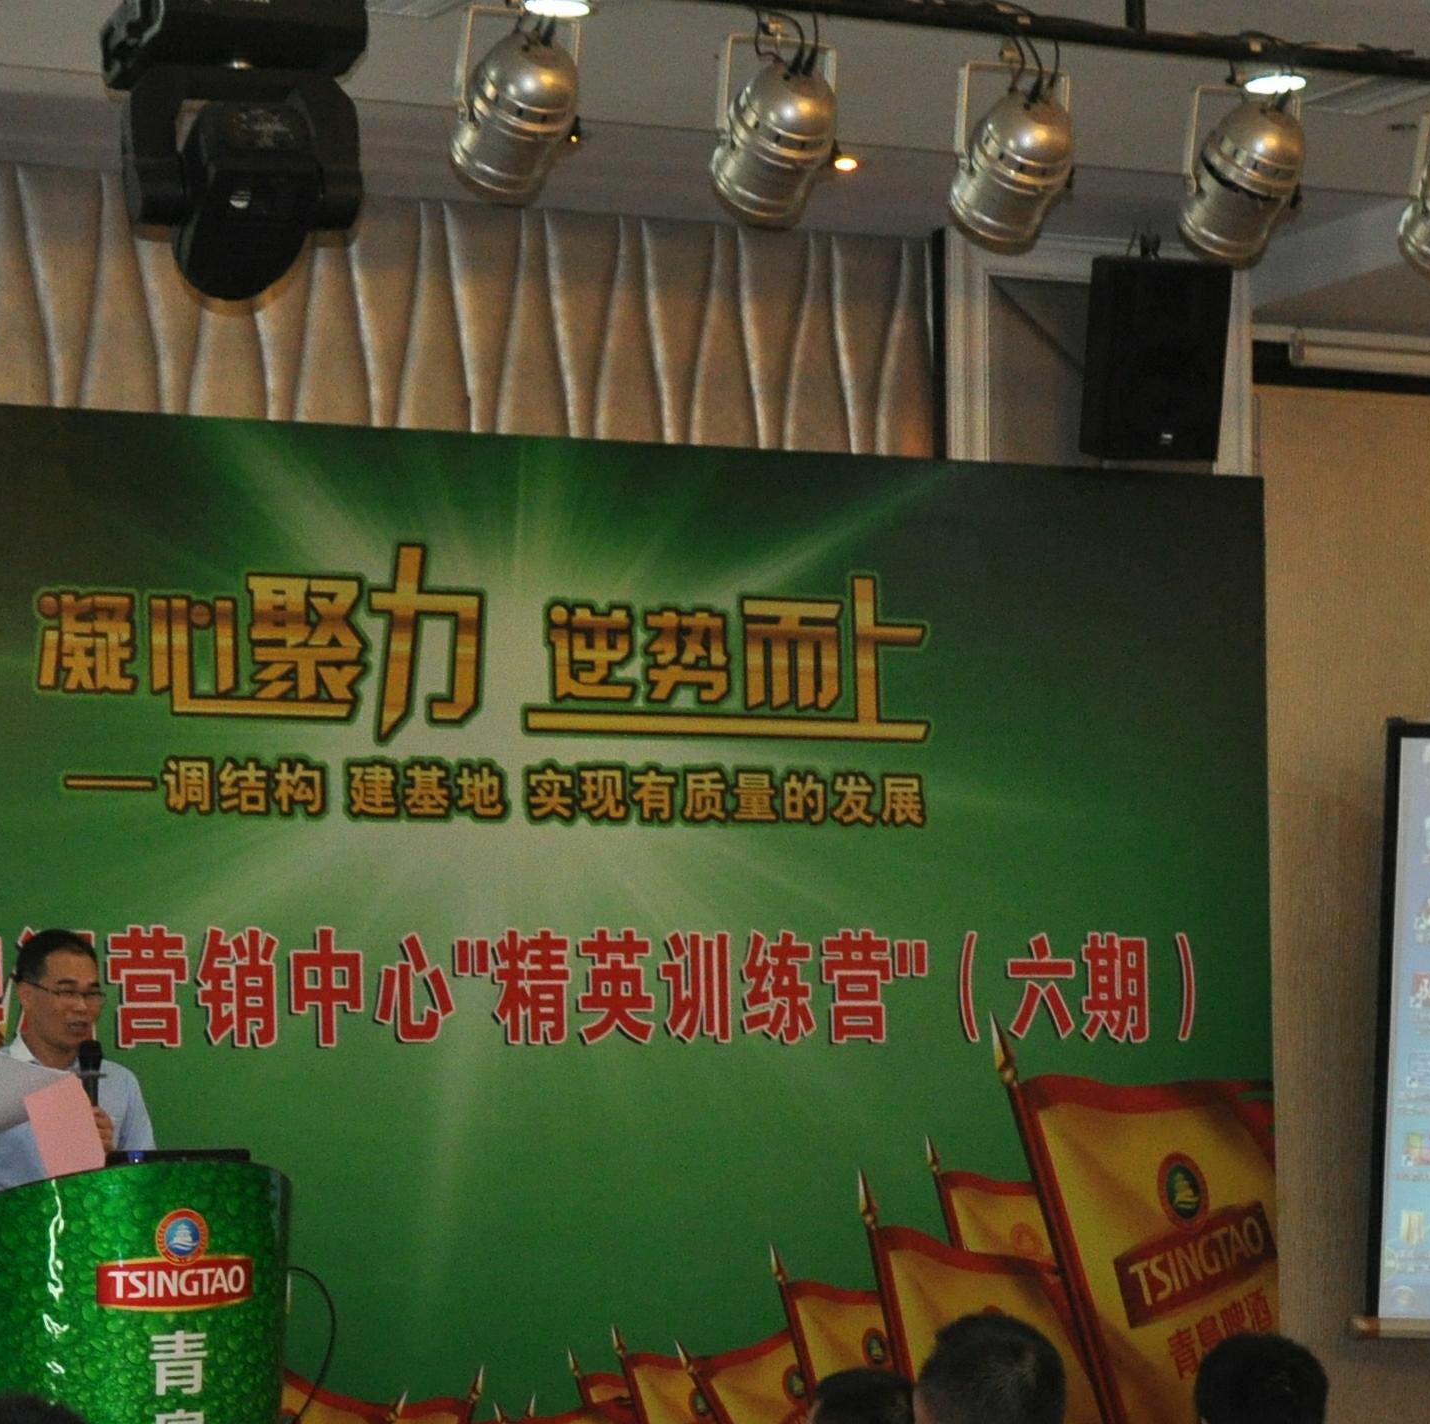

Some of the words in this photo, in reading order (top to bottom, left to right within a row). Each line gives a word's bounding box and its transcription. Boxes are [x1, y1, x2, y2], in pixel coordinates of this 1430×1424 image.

[36, 543, 486, 742] 凝心聚力
[523, 575, 930, 743] 逆势而上
[348, 765, 506, 818] 建基地
[527, 767, 927, 827] 实现有质量的发展
[107, 1265, 246, 1299] TSINGTAO
[1128, 1217, 1265, 1306] TSINGTAO
